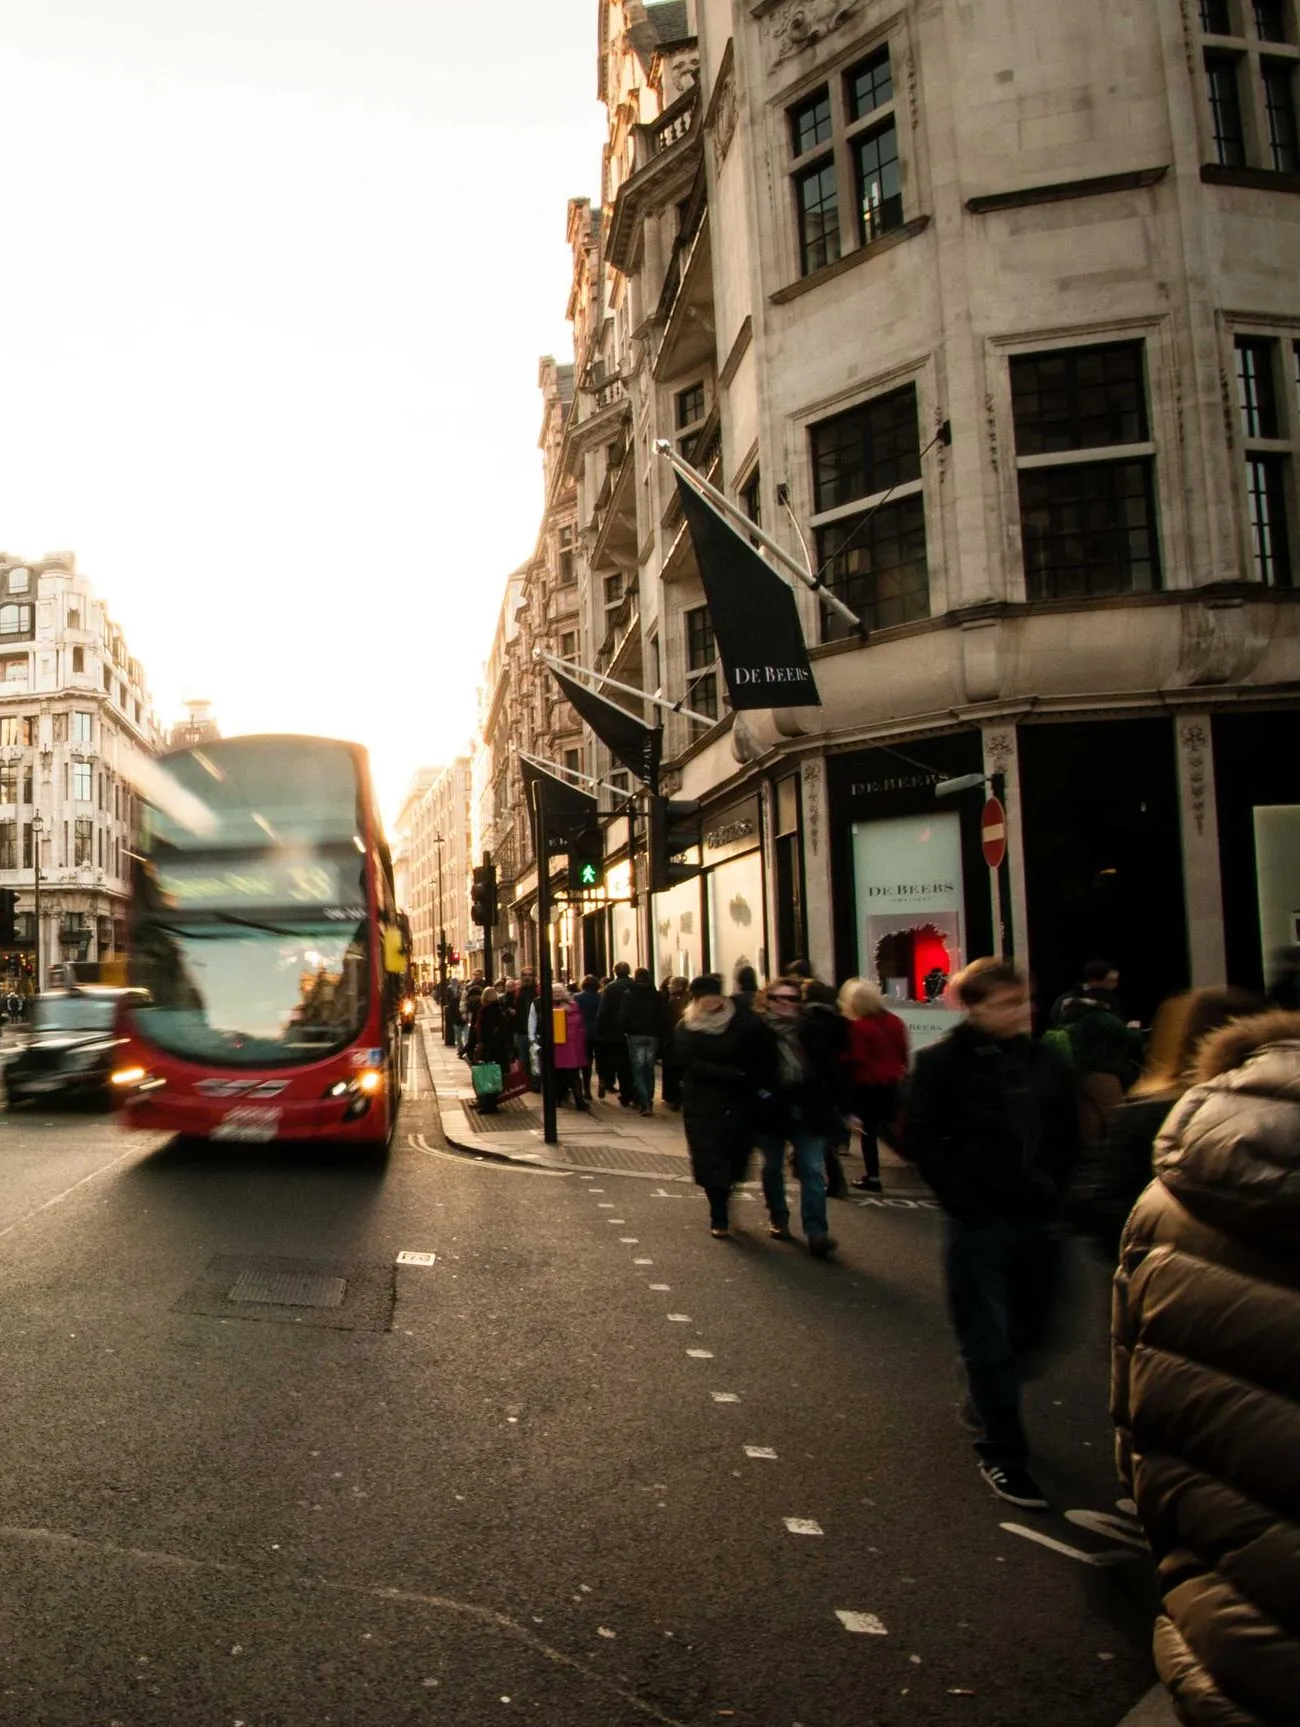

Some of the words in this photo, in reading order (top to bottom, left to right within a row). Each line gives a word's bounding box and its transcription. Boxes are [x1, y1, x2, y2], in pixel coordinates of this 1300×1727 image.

[733, 668, 761, 685] DE
[764, 665, 809, 683] BEERS
[869, 886, 892, 897] DE
[897, 883, 954, 896] BEERS
